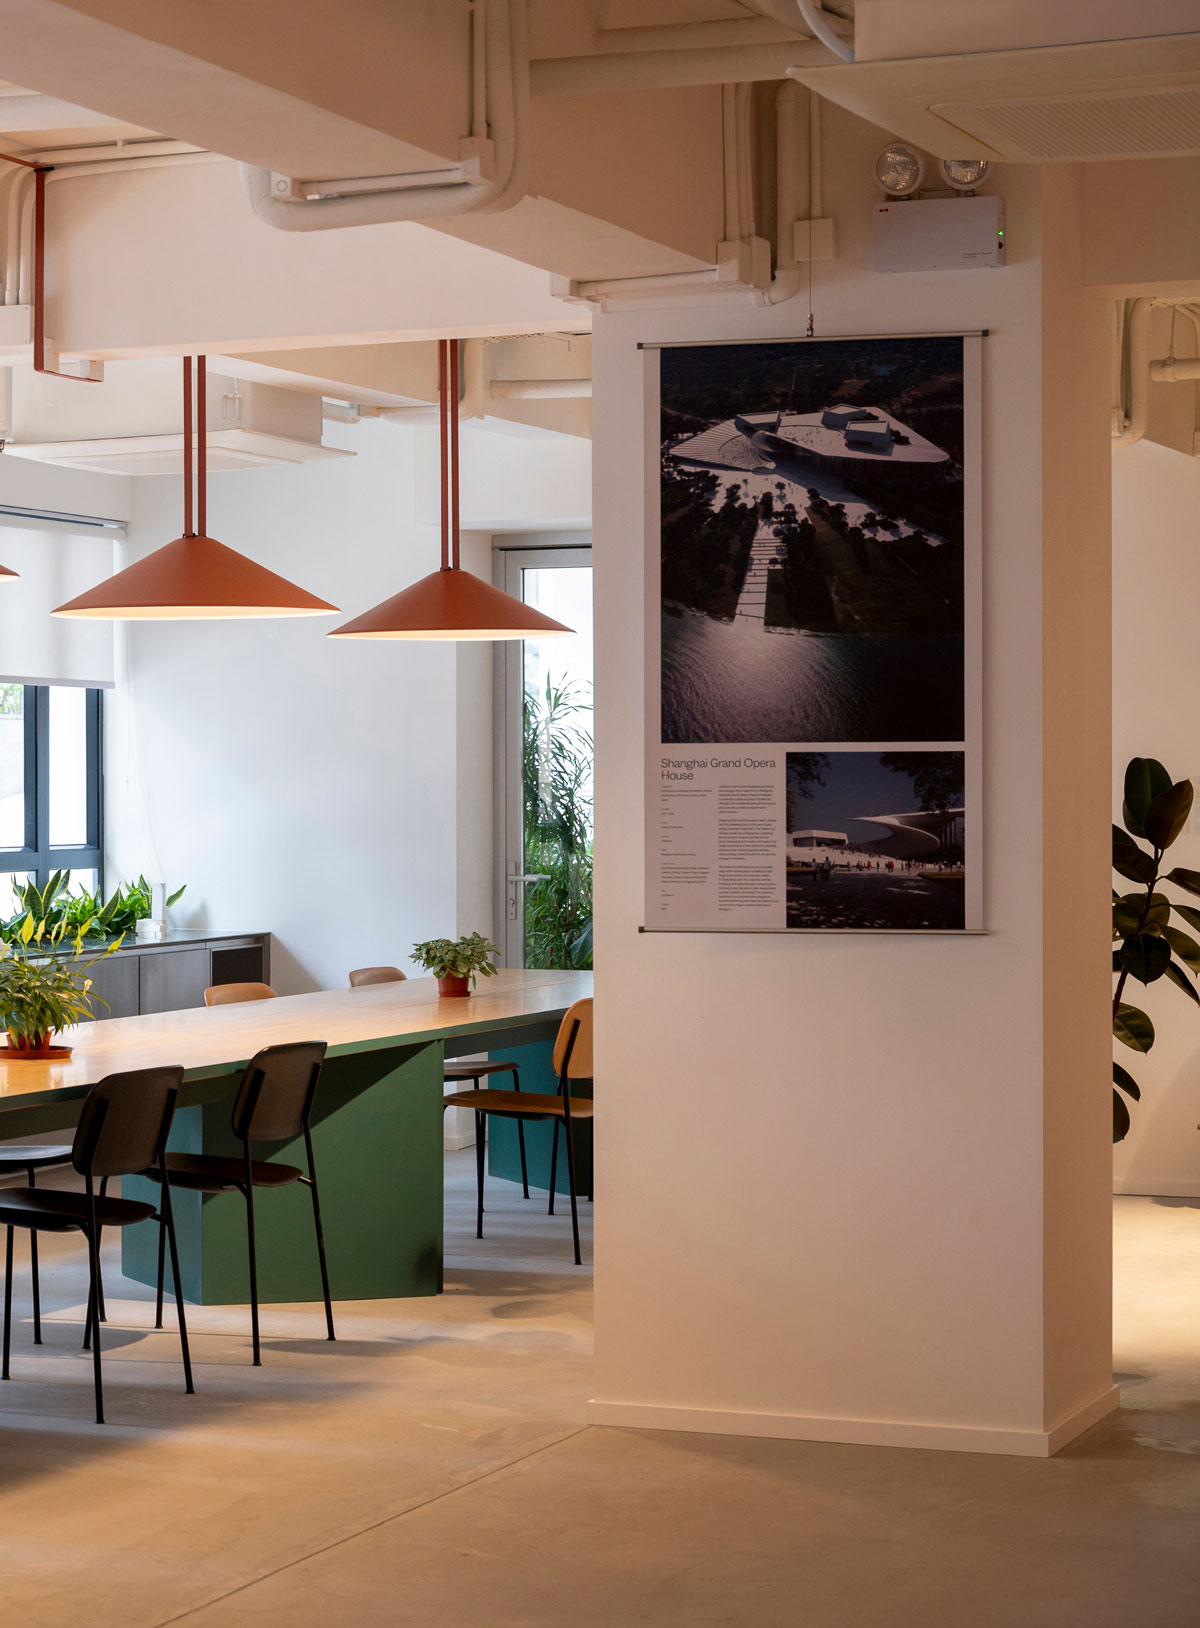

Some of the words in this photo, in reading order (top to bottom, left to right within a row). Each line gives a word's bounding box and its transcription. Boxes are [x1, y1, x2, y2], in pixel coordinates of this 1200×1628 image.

[661, 758, 708, 770] Shanghai
[710, 758, 741, 768] Grand
[743, 758, 776, 769] Opera
[661, 770, 694, 781] House
